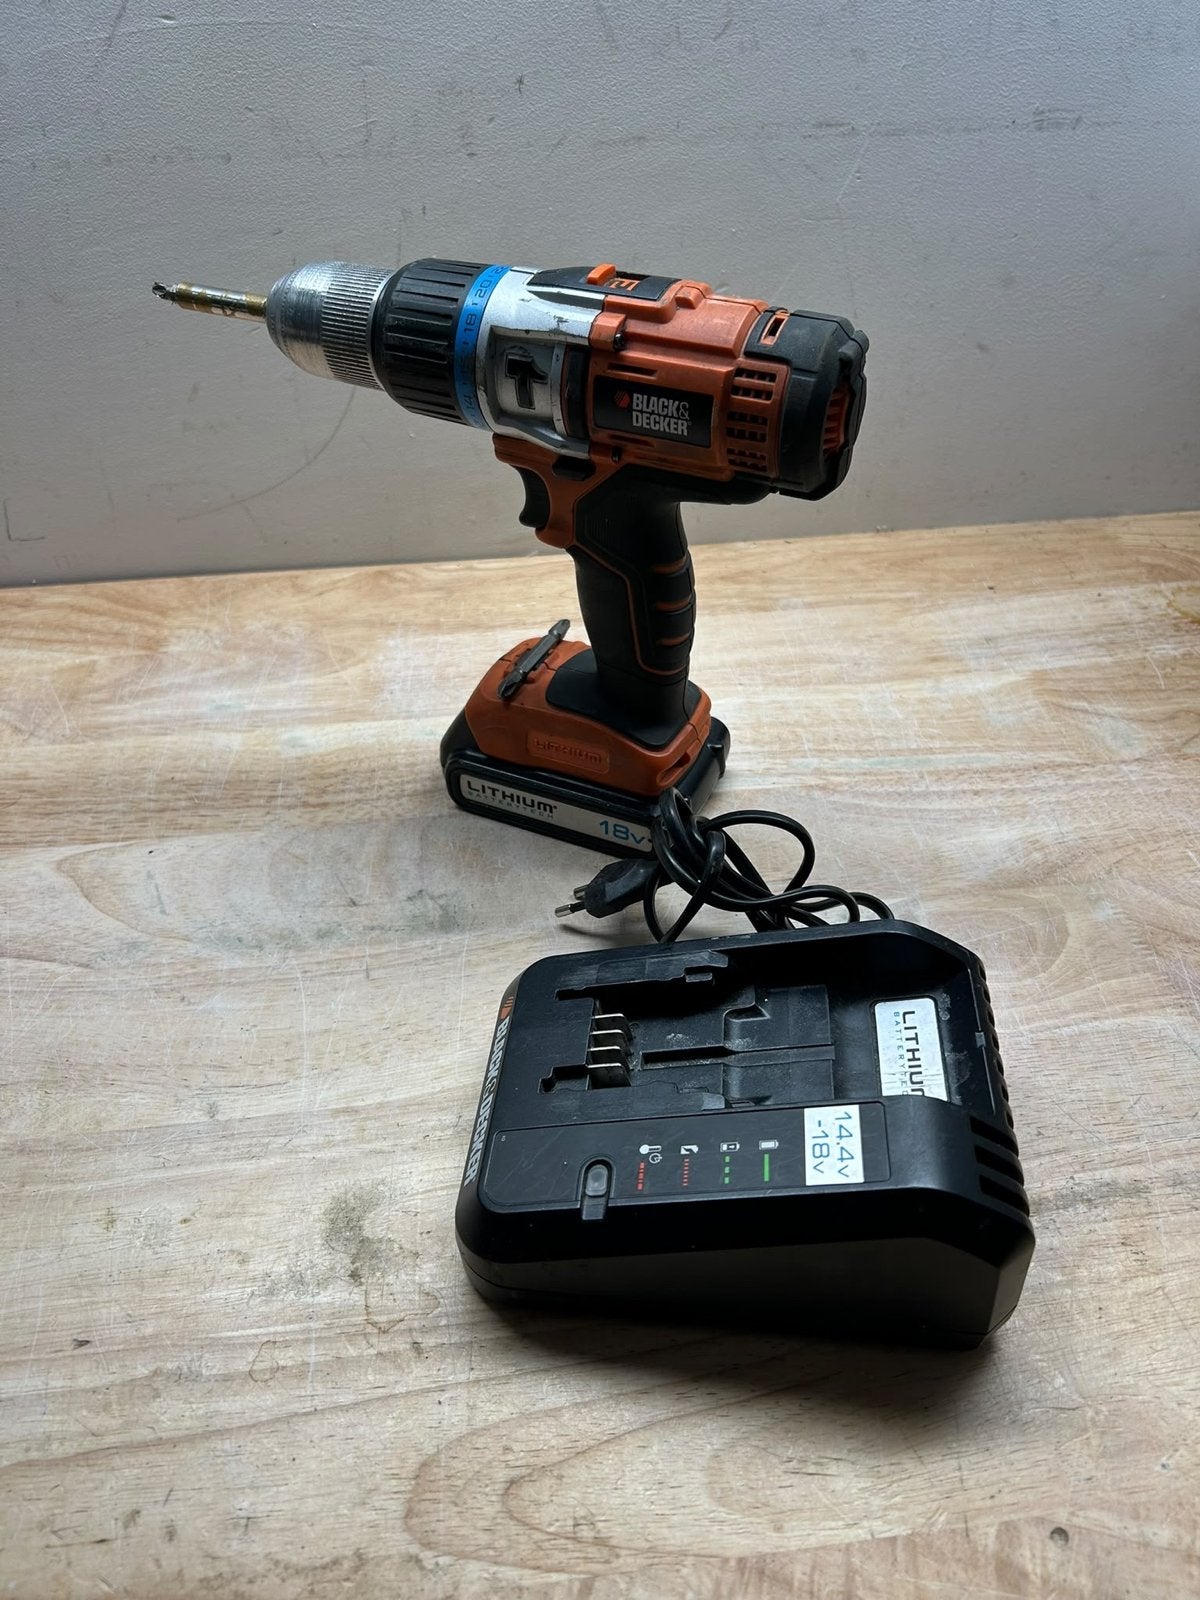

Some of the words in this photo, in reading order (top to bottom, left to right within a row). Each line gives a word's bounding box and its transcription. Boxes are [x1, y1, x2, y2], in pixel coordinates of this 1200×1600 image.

[463, 313, 477, 333] 18
[475, 279, 493, 298] 20
[632, 393, 690, 420] BLACK&
[632, 412, 688, 436] DECKER
[467, 780, 554, 814] LITHIUM
